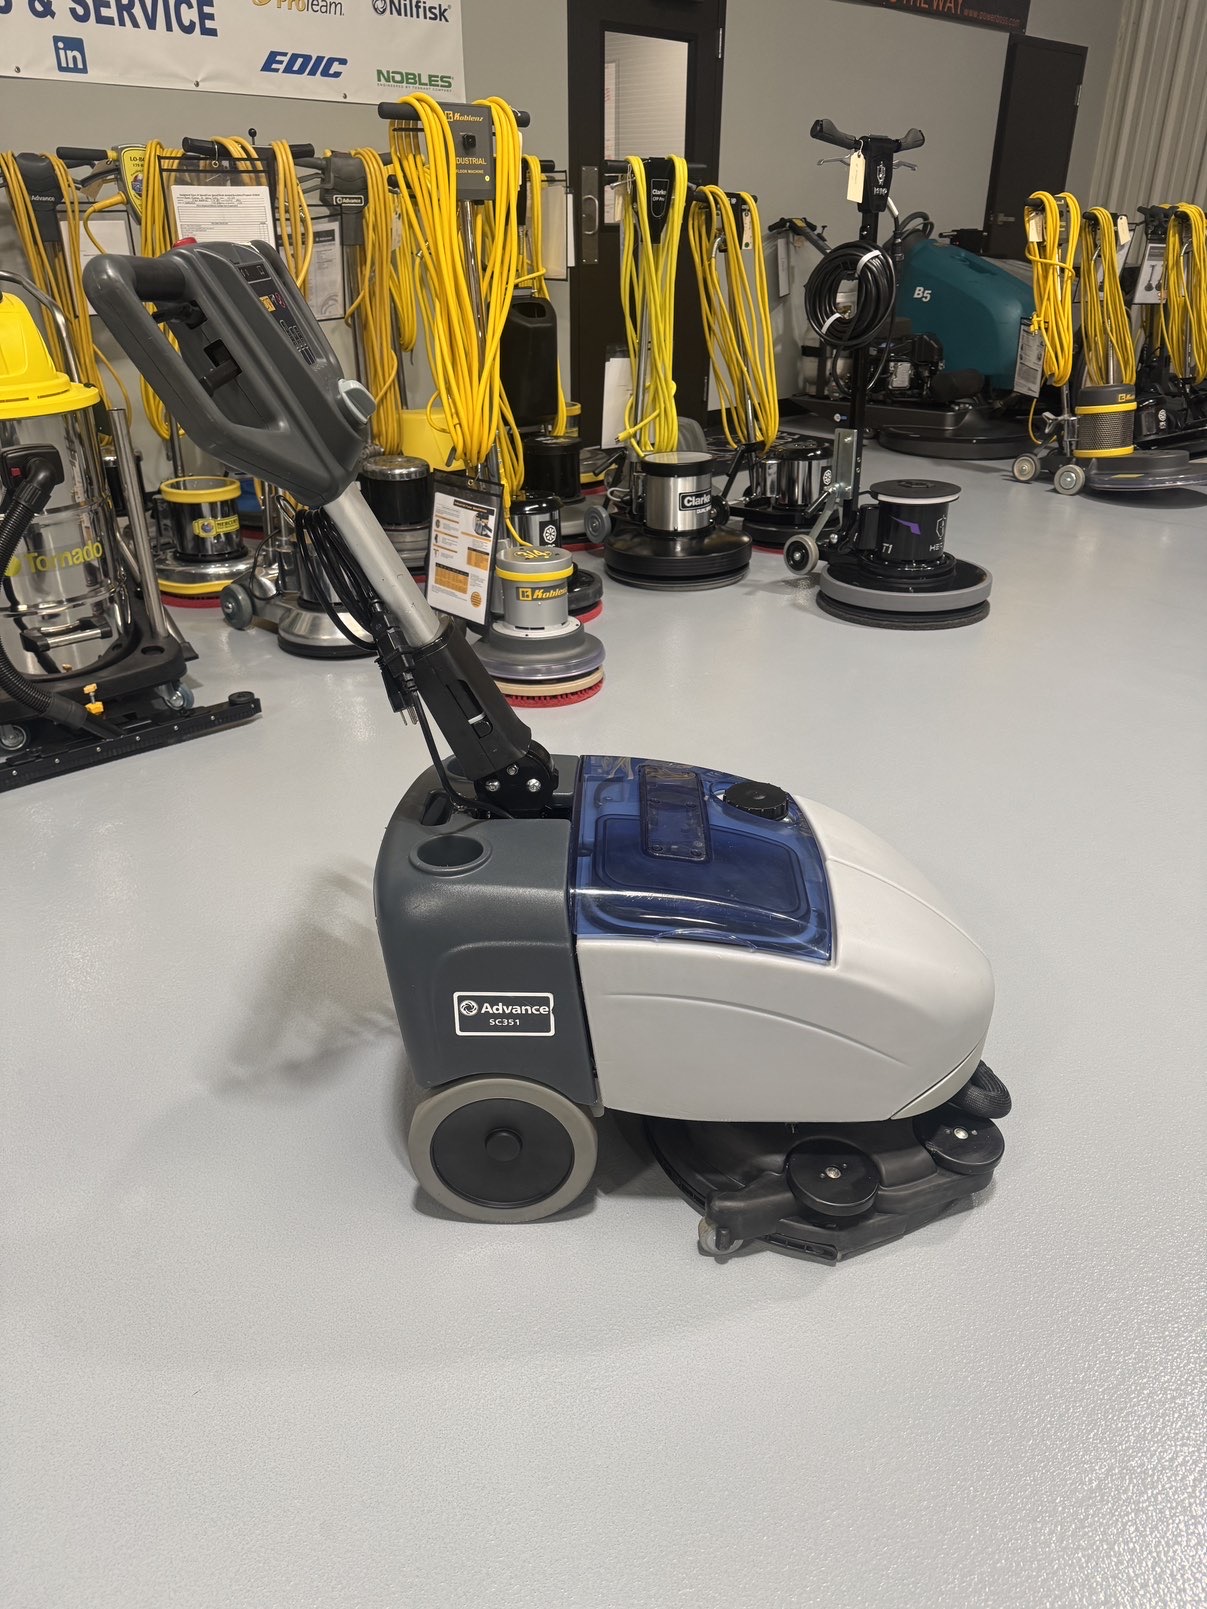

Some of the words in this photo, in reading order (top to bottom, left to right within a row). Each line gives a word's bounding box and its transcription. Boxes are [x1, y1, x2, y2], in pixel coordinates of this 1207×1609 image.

[69, 0, 218, 37] SERVICE
[389, 0, 449, 22] Nilfisk
[57, 41, 84, 69] in
[260, 50, 348, 79] EDIC
[376, 69, 453, 88] NOBLES
[456, 157, 488, 165] DUSTRIAL
[913, 286, 932, 302] B5
[480, 1002, 549, 1014] Advance
[489, 1018, 520, 1026] SC351
